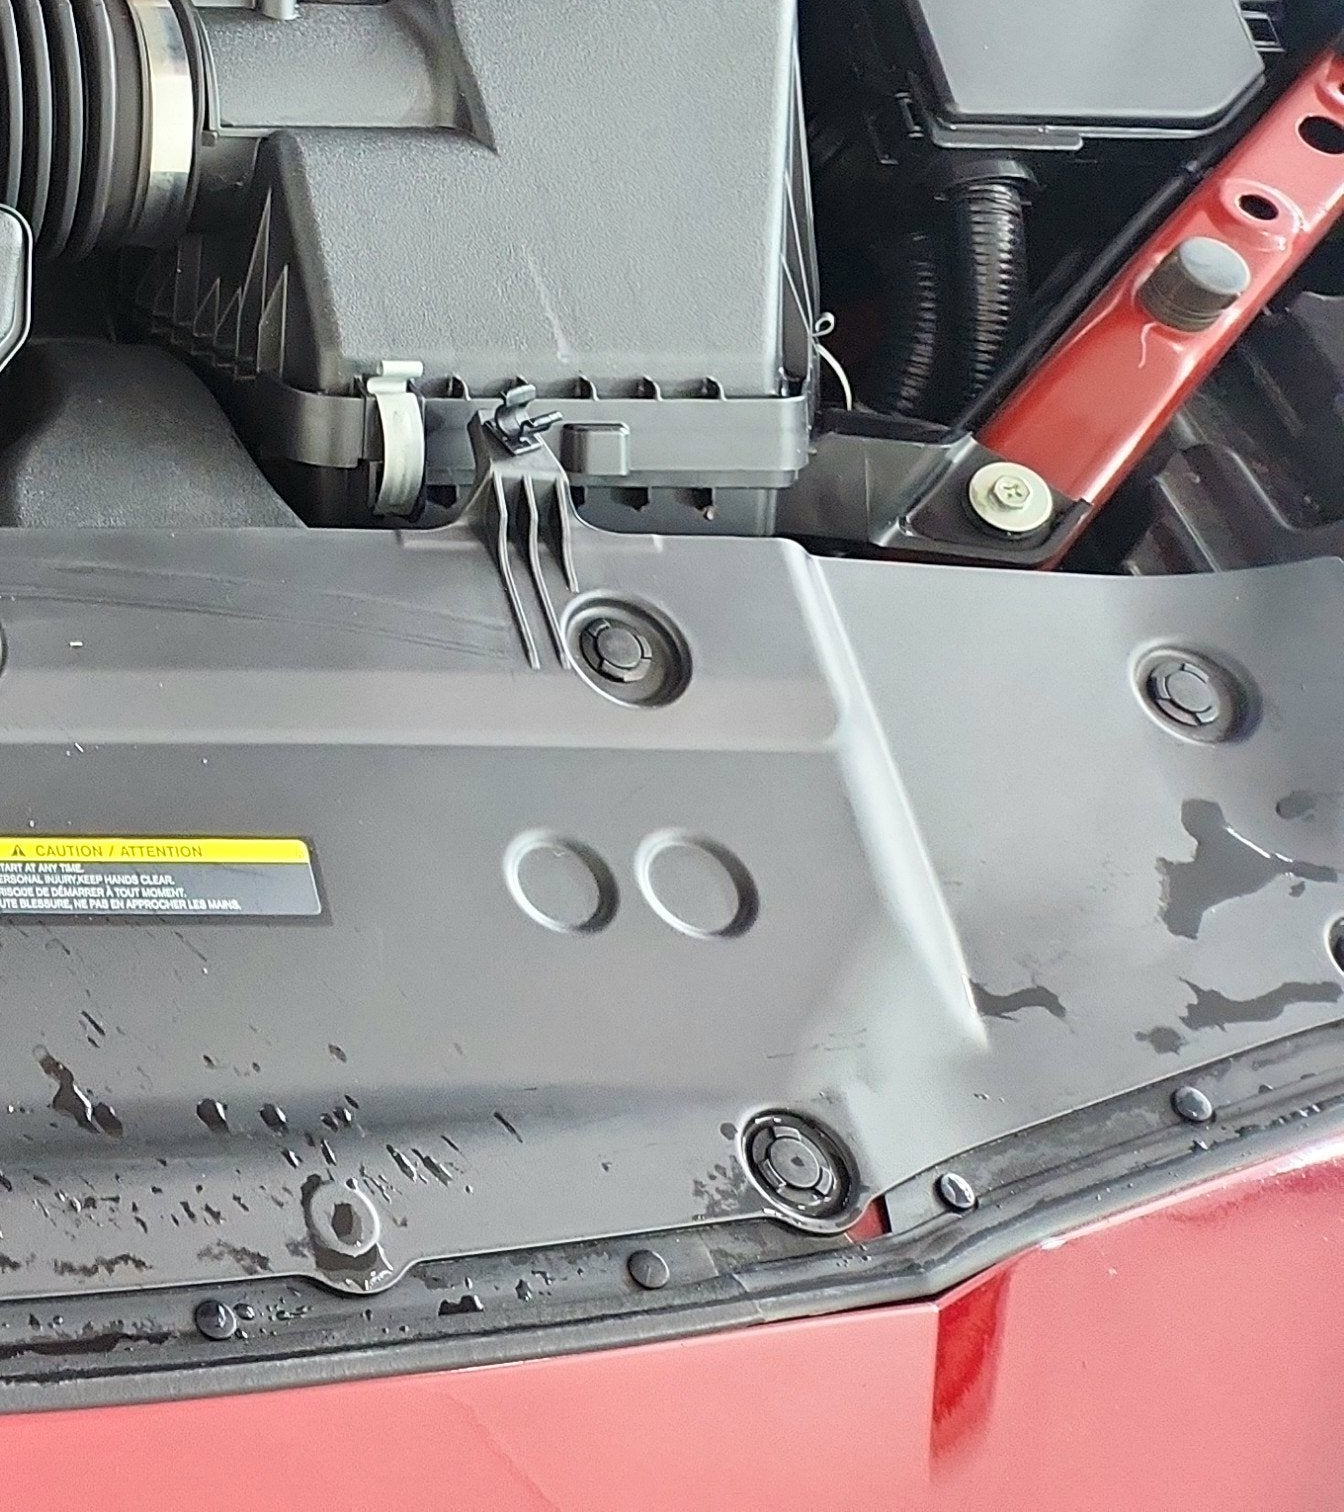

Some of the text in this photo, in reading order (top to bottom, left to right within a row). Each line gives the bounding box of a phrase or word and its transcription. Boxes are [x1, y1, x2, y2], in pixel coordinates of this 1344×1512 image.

[36, 844, 103, 857] CAUTION
[120, 845, 203, 858] ATTENTION
[25, 863, 36, 872] AT
[38, 863, 58, 872] ANY
[60, 863, 84, 873] TIME.
[104, 874, 138, 884] HANDS
[140, 874, 176, 885] CLEAR.
[36, 888, 50, 897] DE
[51, 885, 105, 897] DÉMARRER
[106, 886, 114, 897] À
[115, 888, 140, 898] TOUT
[142, 888, 187, 898] MOMENT.
[20, 898, 72, 910] BLESSURE,
[74, 899, 89, 909] NE
[90, 899, 108, 909] PAS
[110, 899, 124, 909] EN
[126, 899, 187, 910] APPROCHER
[188, 899, 208, 910] LES
